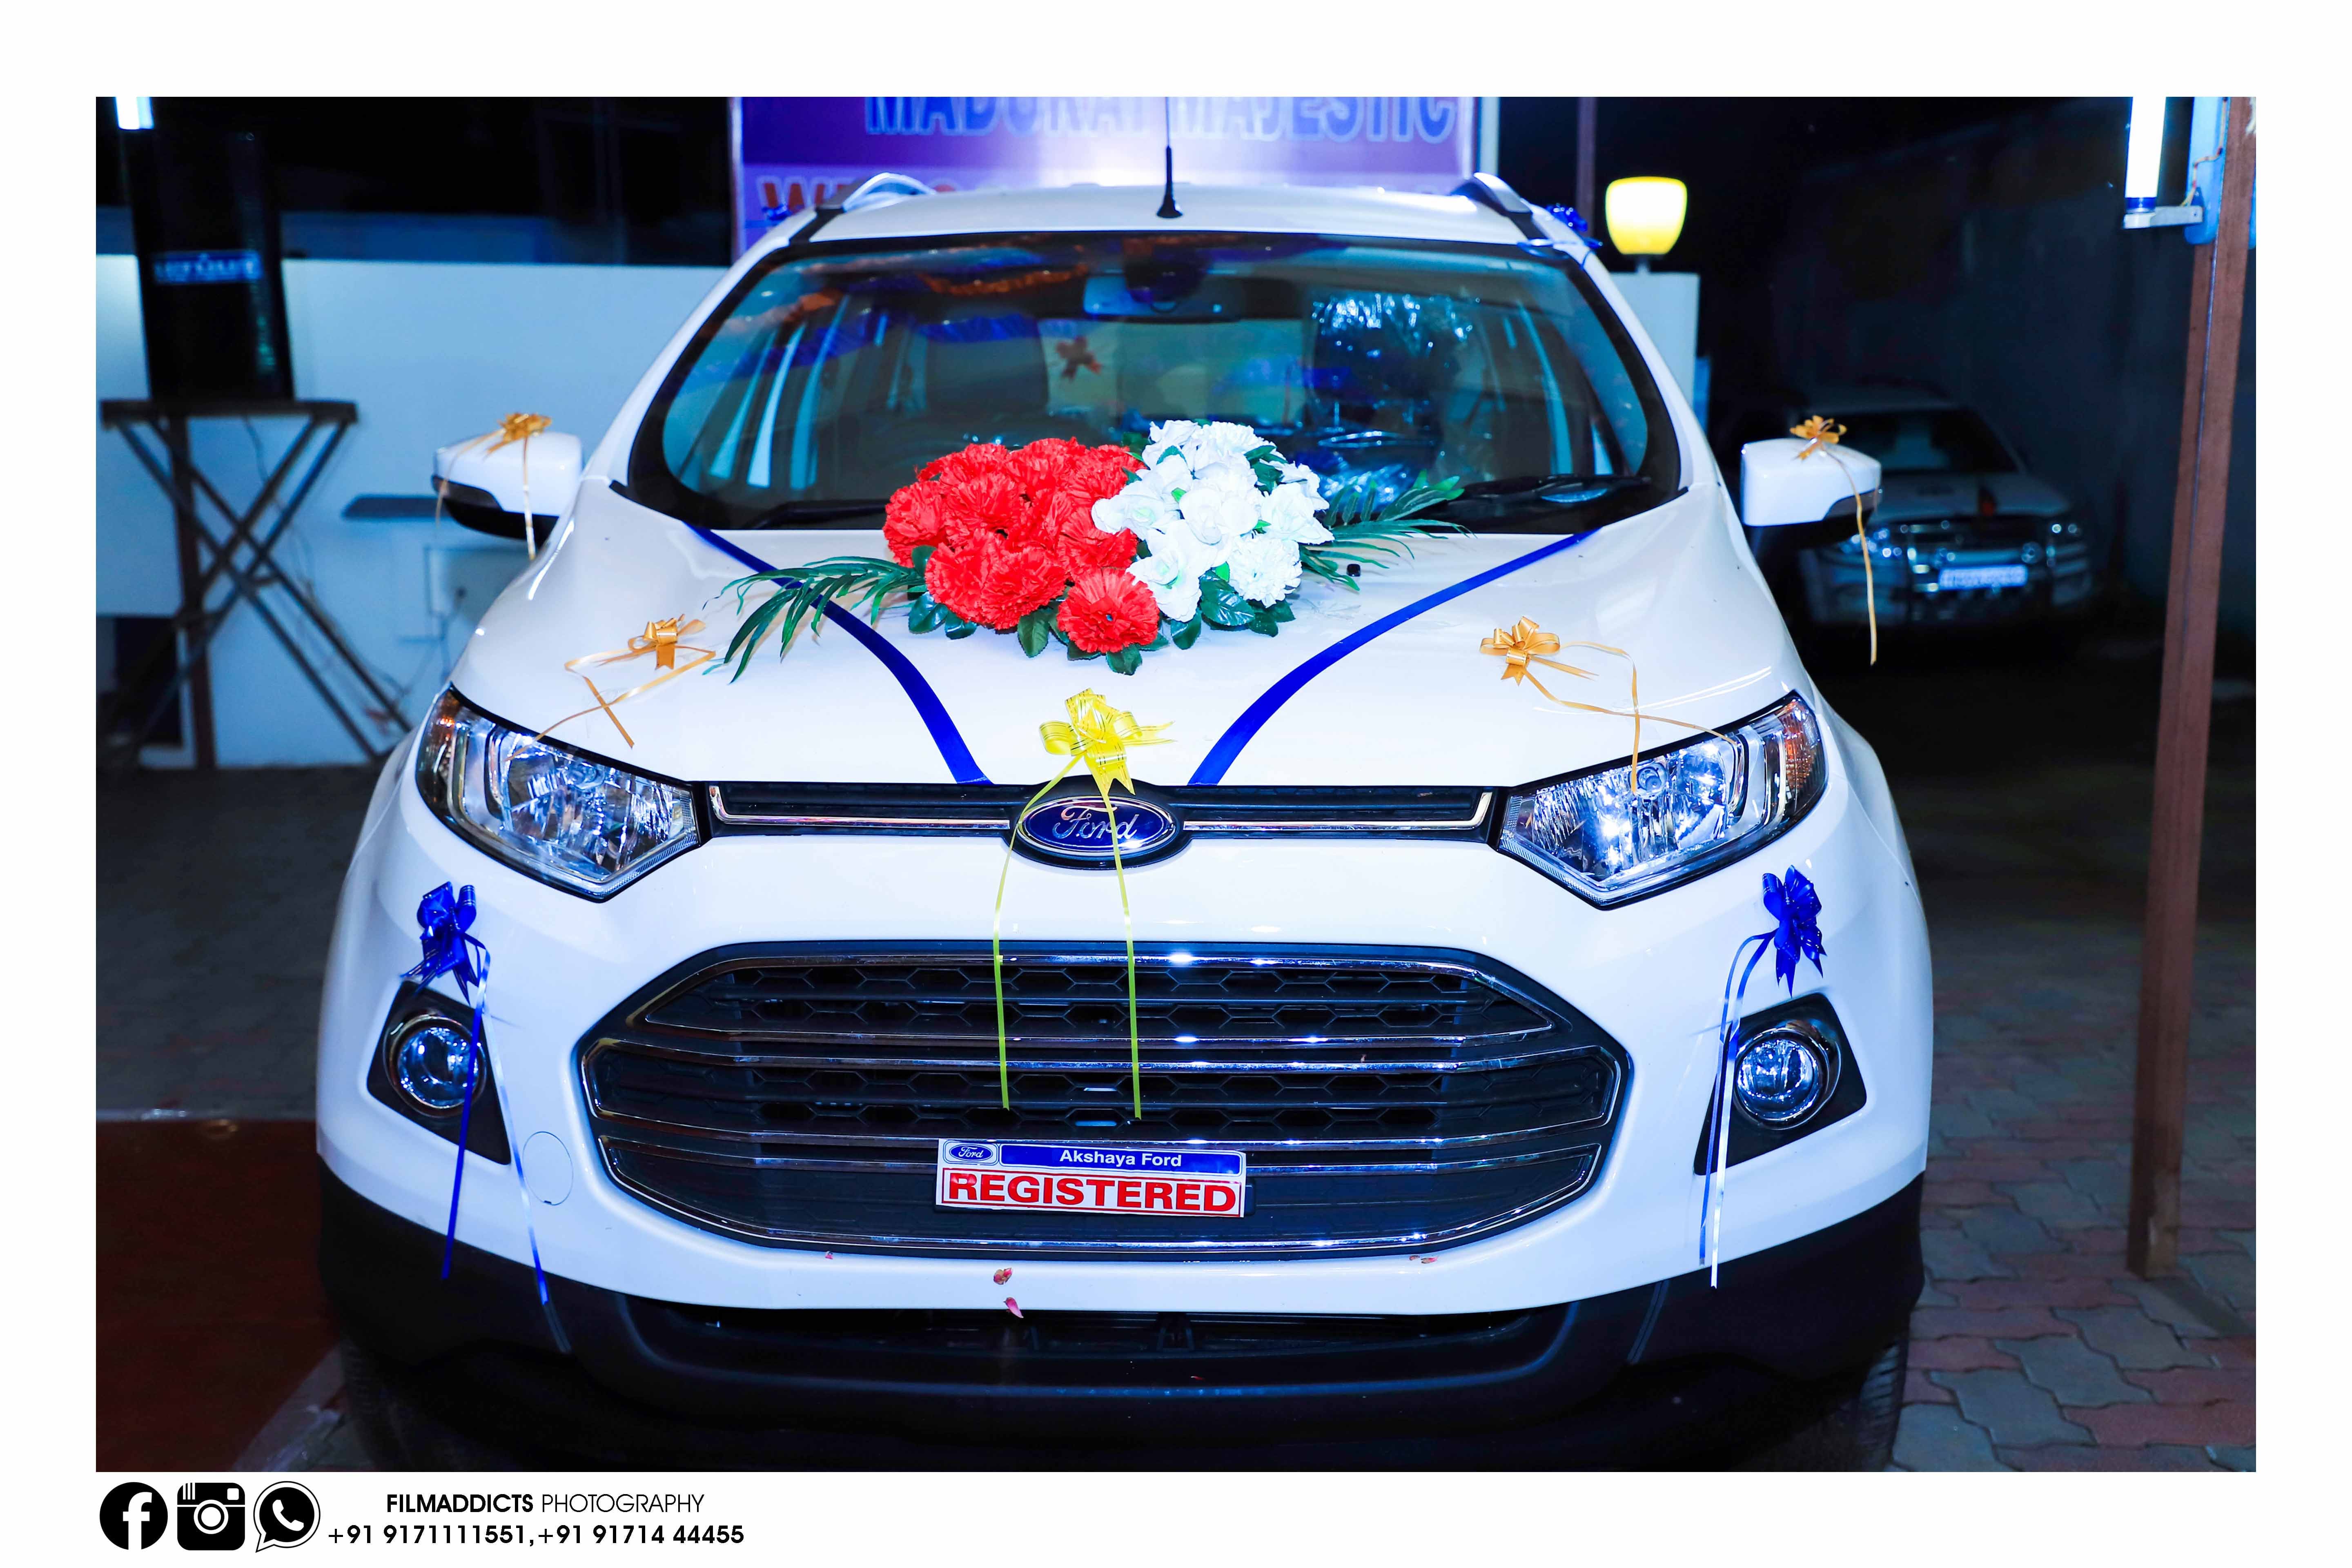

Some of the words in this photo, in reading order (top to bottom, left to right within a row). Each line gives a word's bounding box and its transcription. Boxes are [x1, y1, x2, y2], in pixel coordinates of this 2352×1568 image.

[1052, 806, 1139, 839] Ford
[958, 1146, 984, 1158] Ford
[1060, 1149, 1135, 1167] Akshaya
[1142, 1153, 1182, 1167] Ford
[949, 1172, 1236, 1212] REGISTERED
